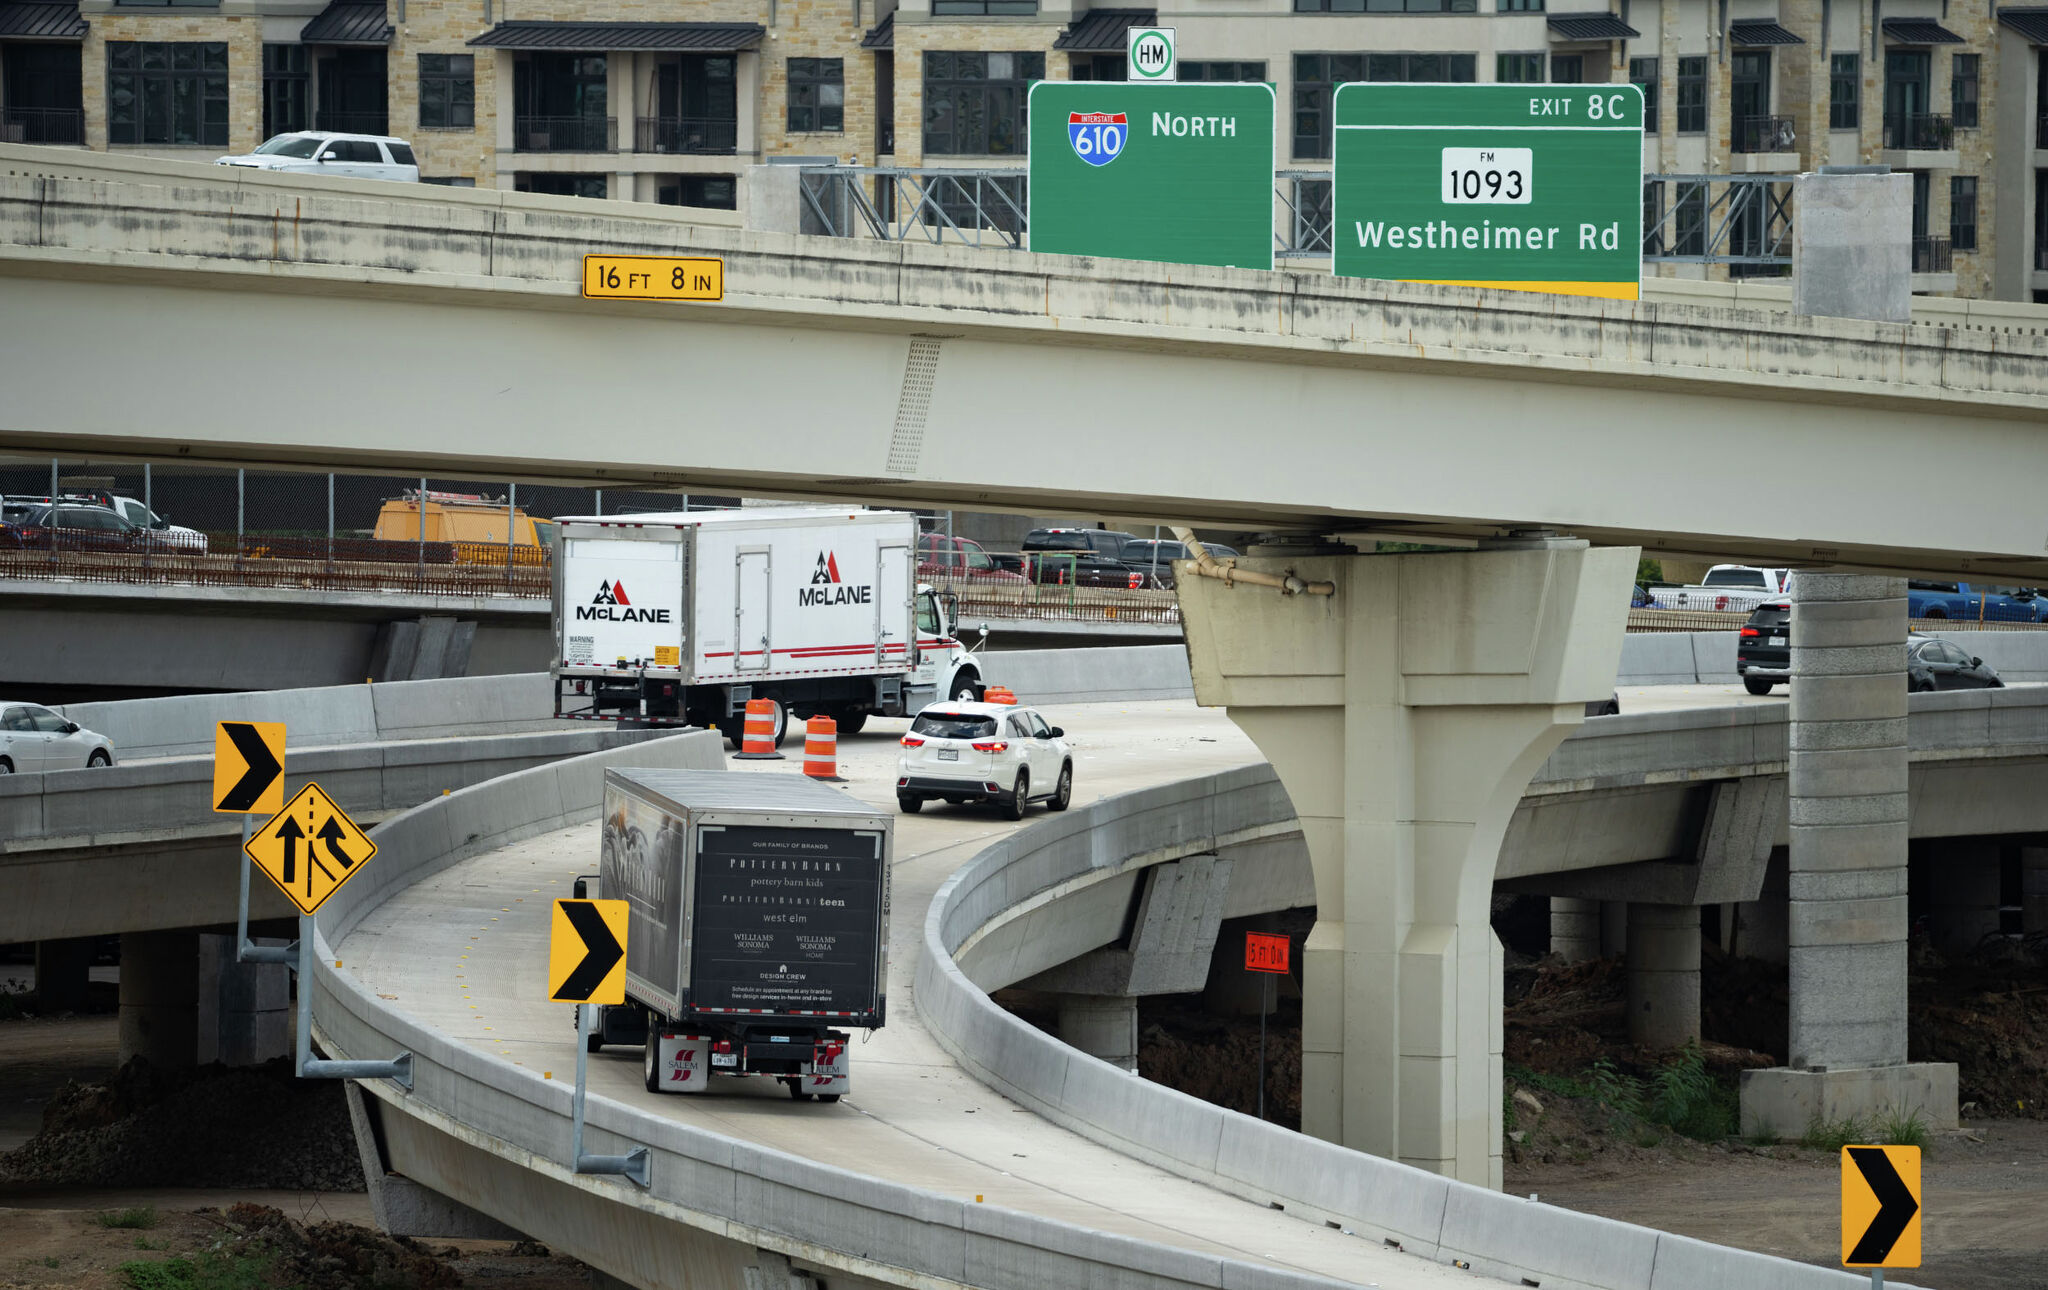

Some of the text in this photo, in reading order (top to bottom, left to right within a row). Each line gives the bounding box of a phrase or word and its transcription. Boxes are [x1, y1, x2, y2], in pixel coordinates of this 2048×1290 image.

[1140, 44, 1164, 64] HM
[1529, 94, 1625, 120] EXIT 8C
[1081, 115, 1114, 123] INTERSTATE
[1152, 112, 1236, 137] NORTH
[1075, 126, 1121, 155] 610
[1480, 152, 1495, 163] FM
[1450, 170, 1523, 200] 1093
[1355, 219, 1619, 251] Westheimer Rd
[599, 265, 711, 291] 16 FT 8 IN
[799, 586, 871, 606] McLANE
[576, 606, 670, 623] McLANE
[801, 842, 829, 850] BRANDS
[751, 877, 824, 888] pottery barn kids
[820, 897, 845, 907] teen
[763, 914, 807, 923] west elm
[734, 933, 774, 941] WILLIAMS
[796, 935, 836, 943] WILLIAMS
[668, 1061, 698, 1070] SALEM
[816, 1065, 840, 1074] ALEM
